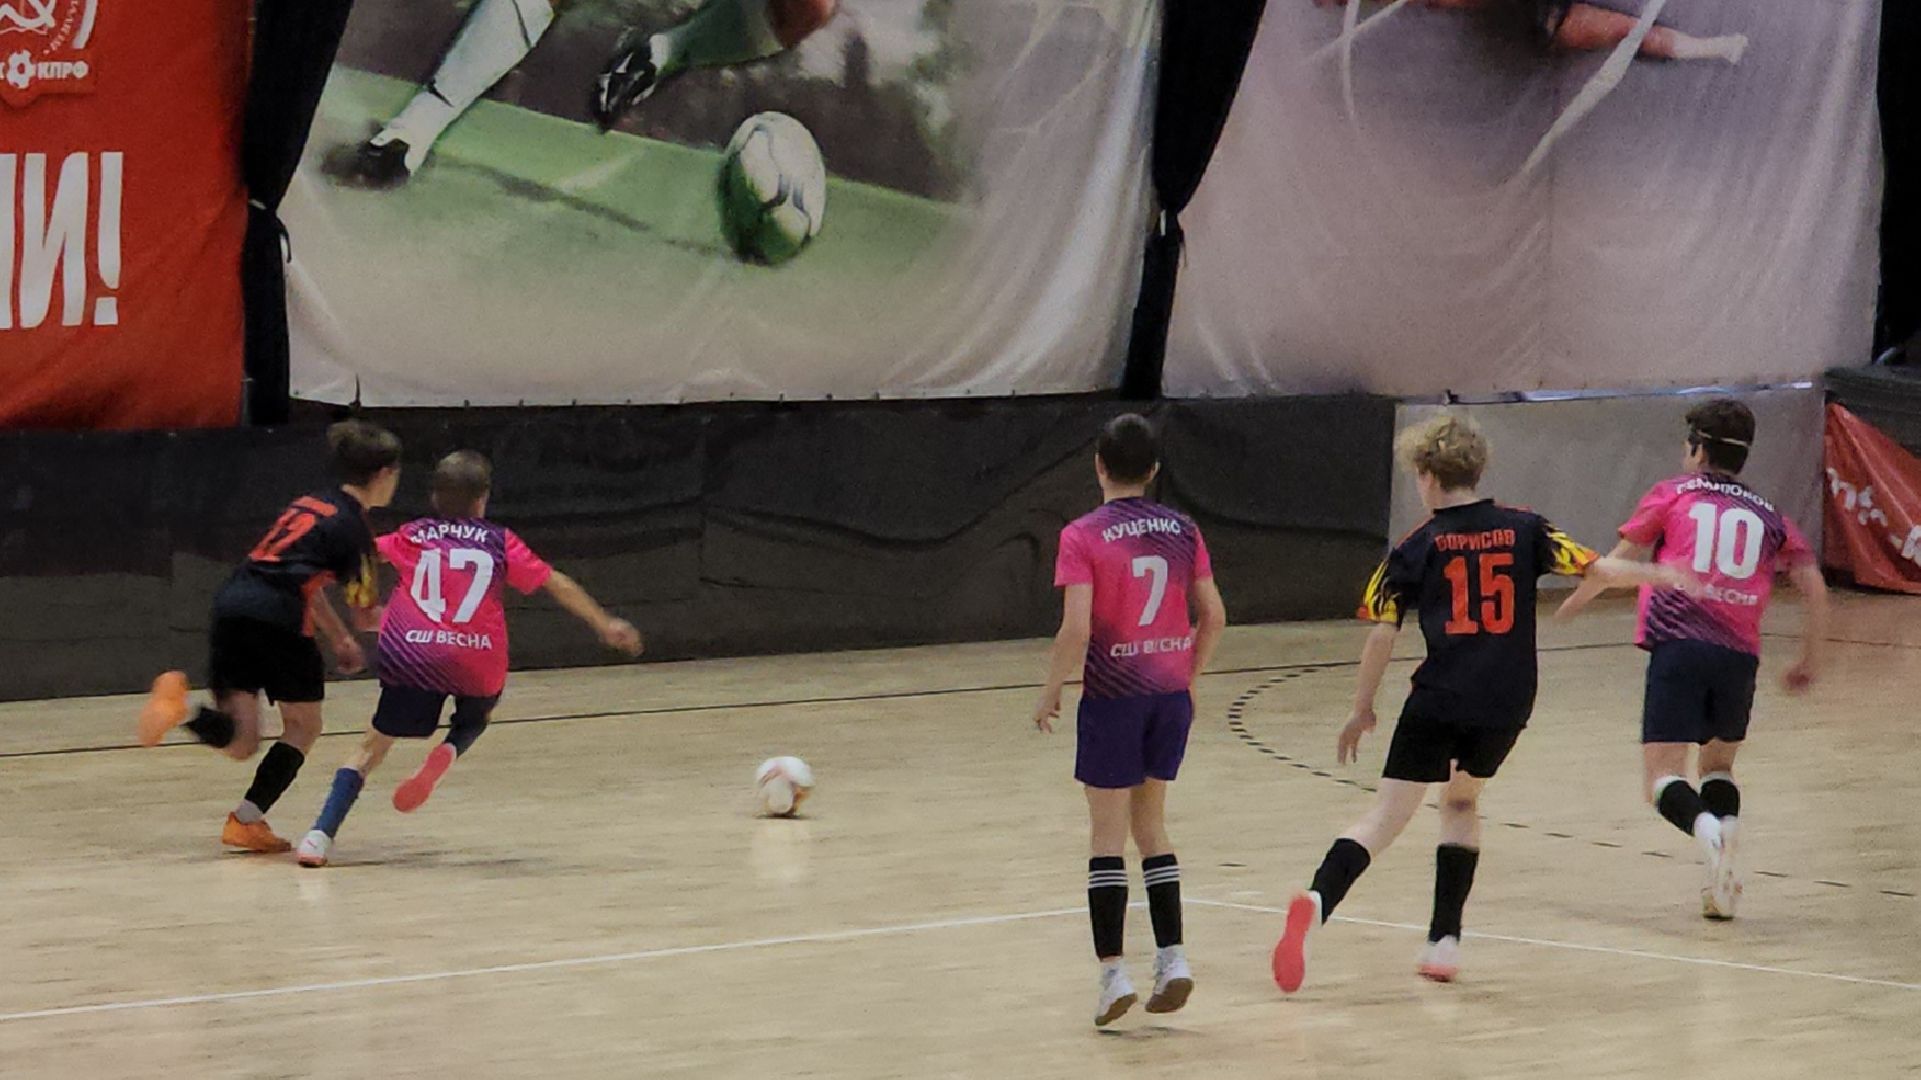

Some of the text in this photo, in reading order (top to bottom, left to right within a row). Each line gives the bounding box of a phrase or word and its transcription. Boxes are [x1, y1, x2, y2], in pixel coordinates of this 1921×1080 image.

[0, 152, 123, 328] И!
[1102, 518, 1181, 543] КУЦЕНКО
[1688, 501, 1764, 579] 10
[410, 547, 494, 623] 47
[1132, 555, 1168, 627] 7
[1444, 552, 1515, 634] 15
[436, 629, 492, 650] ВЕСНА
